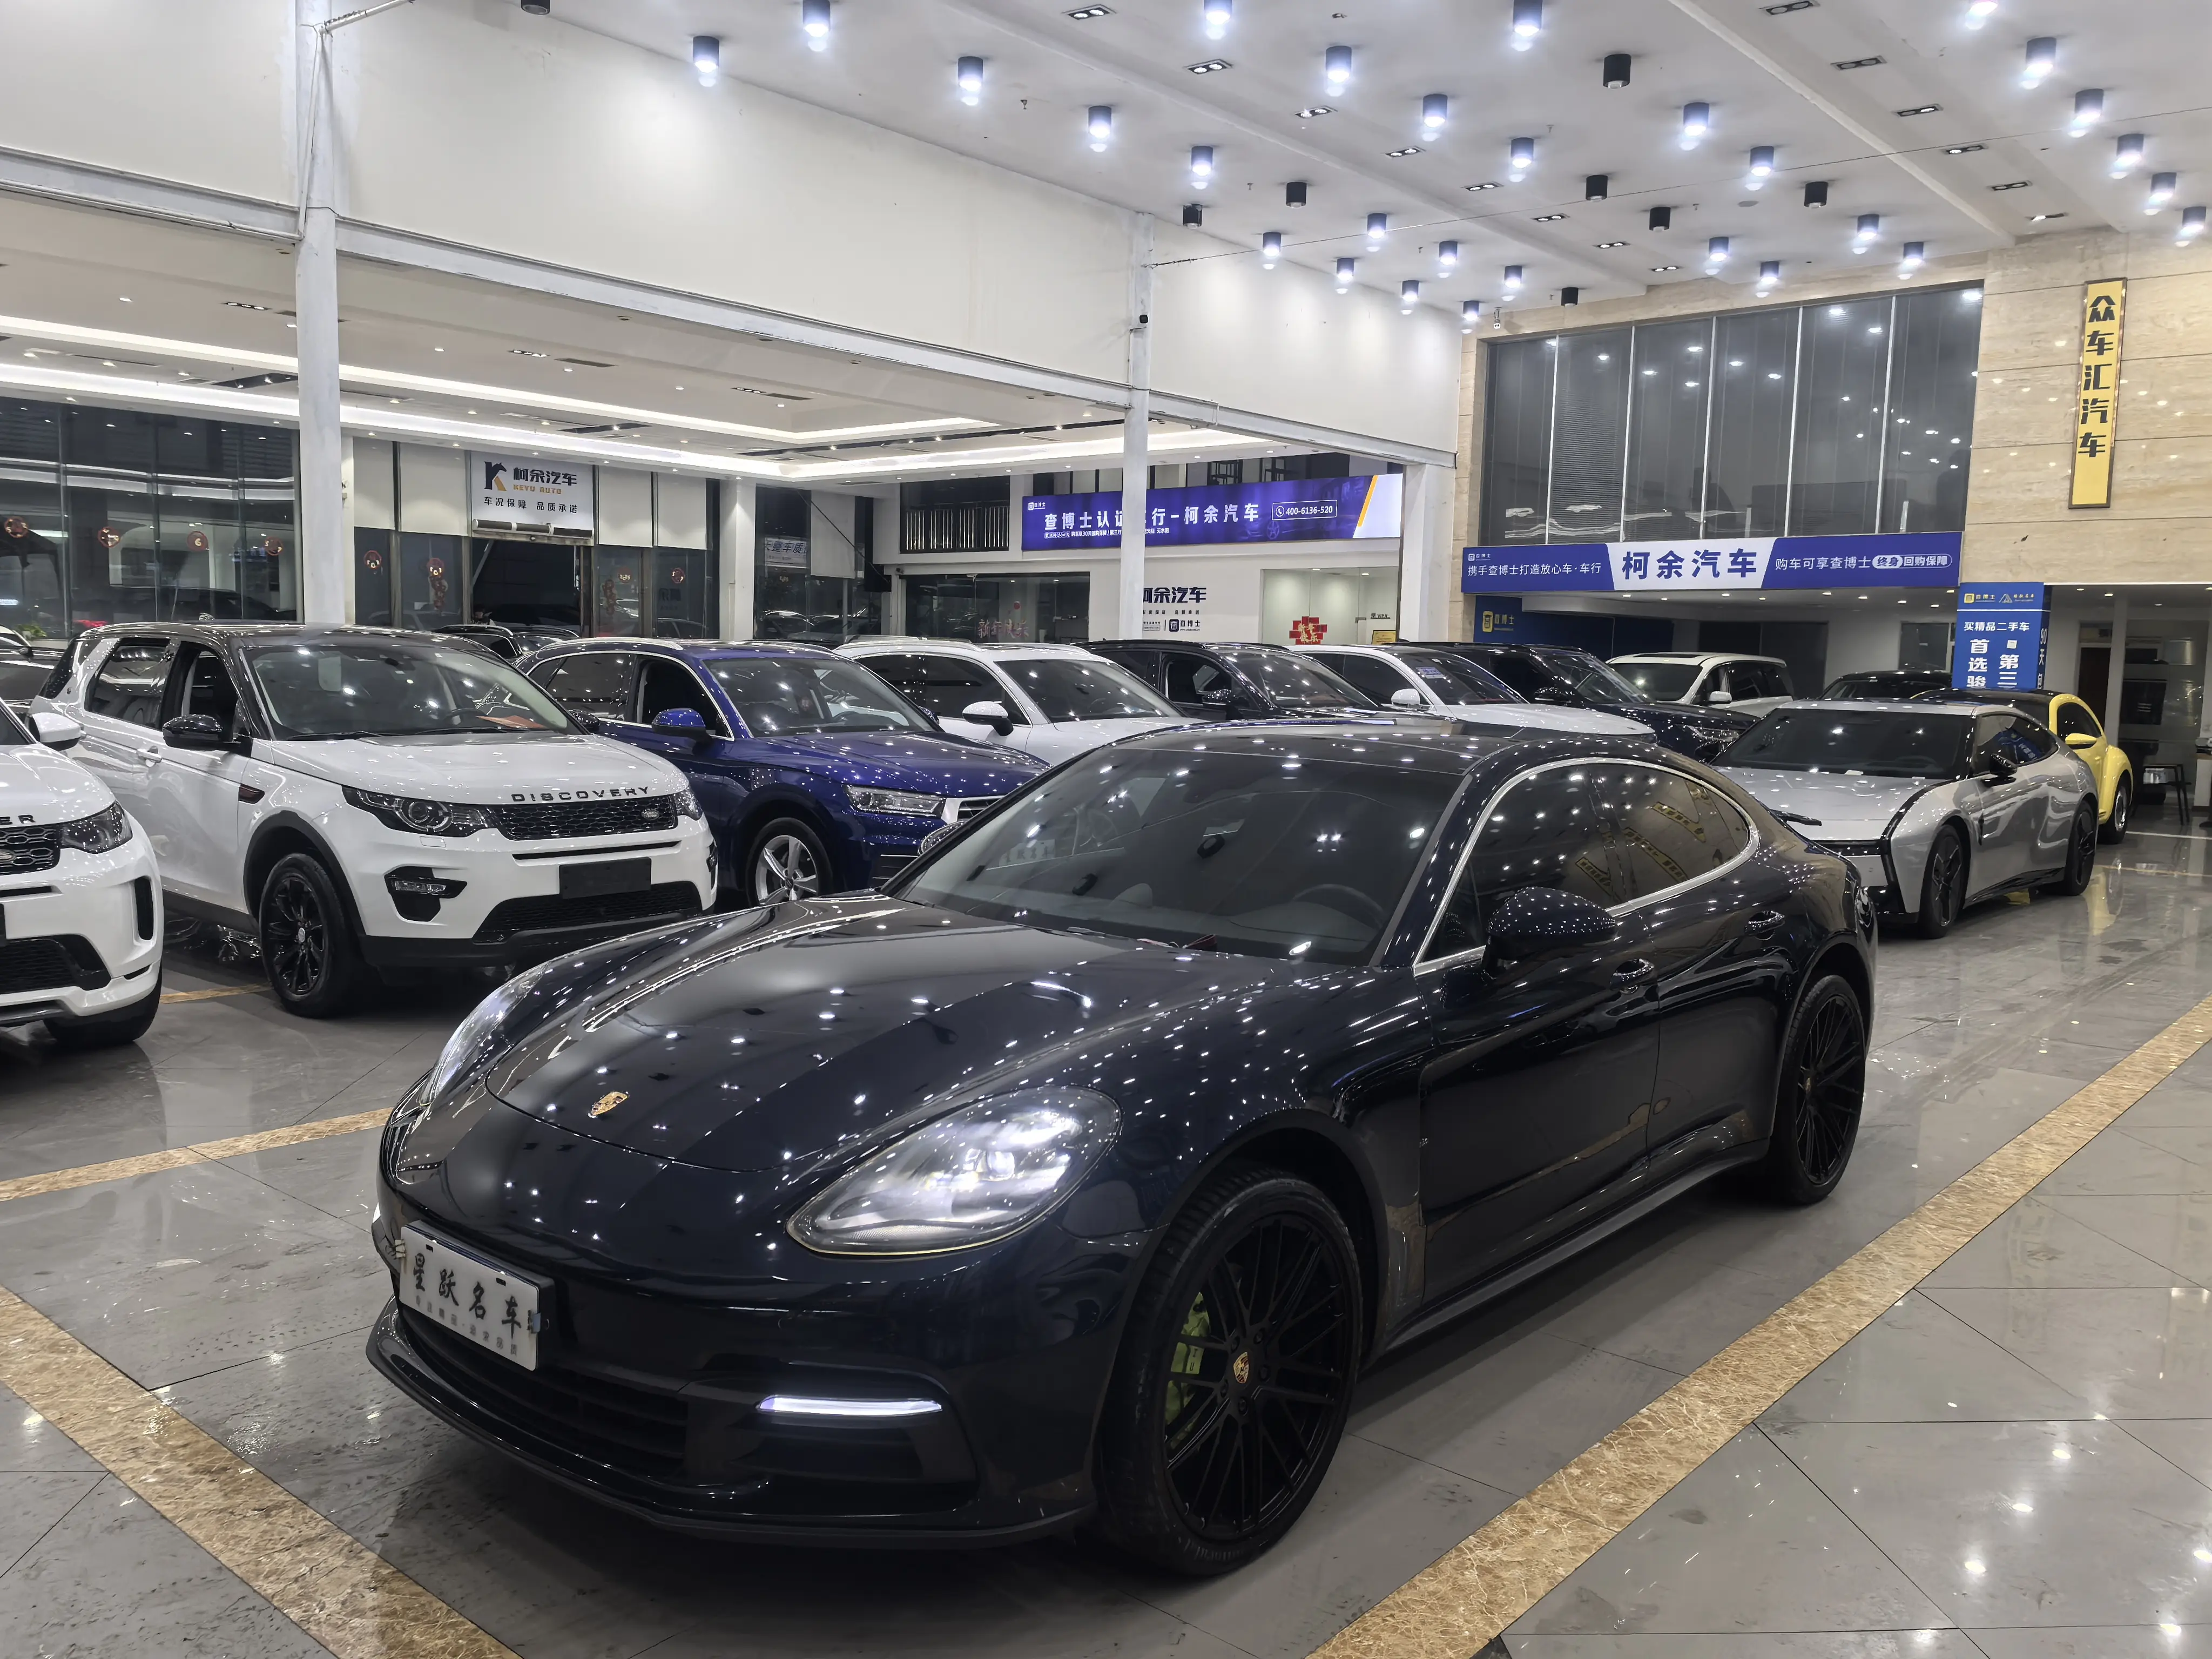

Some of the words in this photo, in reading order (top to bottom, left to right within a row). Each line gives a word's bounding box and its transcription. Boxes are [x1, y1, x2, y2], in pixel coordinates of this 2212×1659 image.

[2078, 295, 2116, 458] 众车汇汽车
[513, 467, 577, 486] 柯余汽车
[539, 487, 562, 495] AUTO
[484, 496, 527, 509] 车况保障
[536, 502, 577, 514] 品质承诺
[1285, 505, 1333, 516] 400-6136-520
[1467, 562, 1602, 577] 携手查博士打造放心车·车行
[1622, 548, 1757, 580] 柯余汽车
[1963, 621, 2030, 632] 买精品二手车
[511, 786, 649, 802] DISCOVERY
